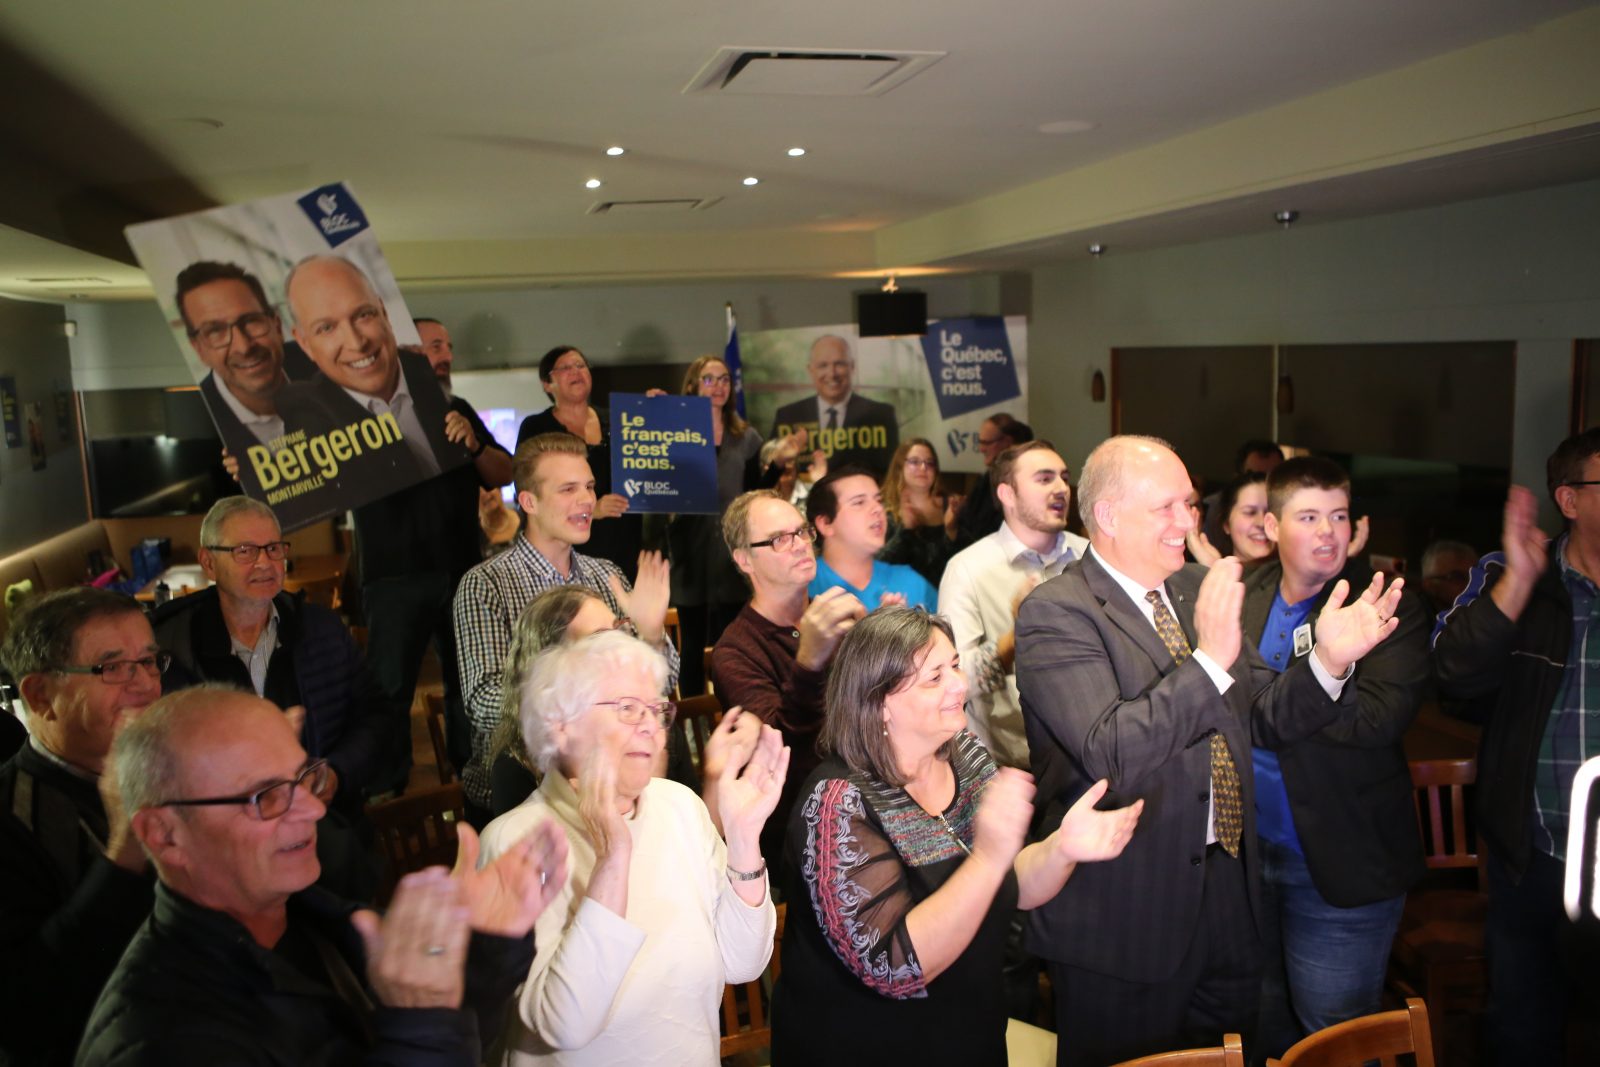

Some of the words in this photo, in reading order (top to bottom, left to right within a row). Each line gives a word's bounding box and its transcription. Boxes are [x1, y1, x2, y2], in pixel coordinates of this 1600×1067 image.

[940, 329, 962, 346] Le
[941, 345, 1007, 365] Québec,
[942, 364, 982, 380] c'est
[942, 382, 986, 396] nous.
[621, 412, 645, 427] Le
[621, 426, 707, 446] français,
[778, 423, 887, 459] rgeron
[247, 411, 402, 491] Bergeron
[622, 441, 669, 456] c'est
[623, 457, 675, 470] nous.
[266, 474, 325, 506] MONTARVILLE
[643, 481, 670, 490] BLOC
